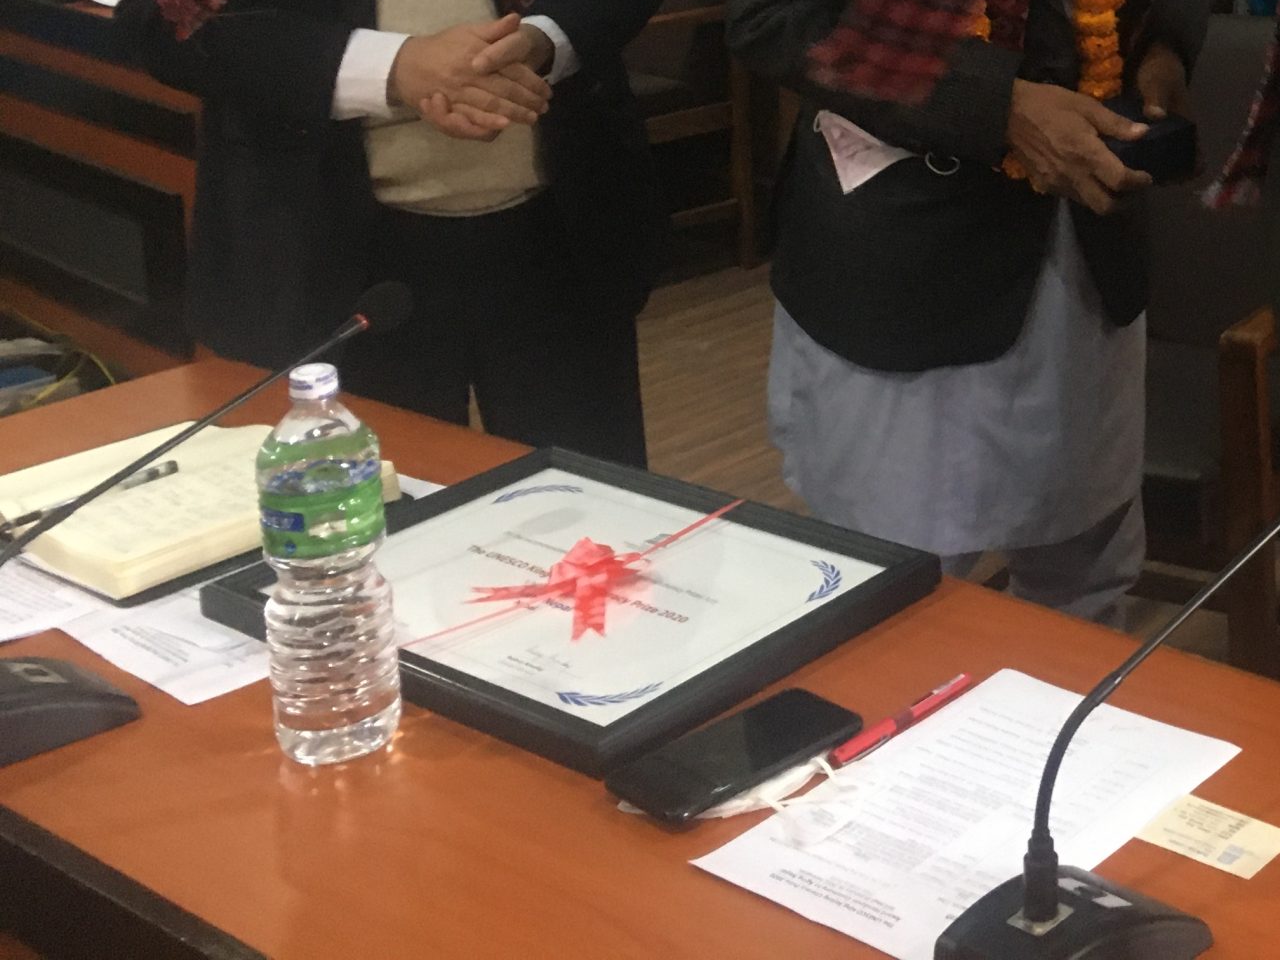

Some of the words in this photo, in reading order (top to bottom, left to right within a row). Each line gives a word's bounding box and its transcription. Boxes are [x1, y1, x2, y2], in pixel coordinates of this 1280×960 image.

[467, 544, 486, 555] The
[486, 550, 530, 570] UNESCO
[630, 599, 658, 615] Prize
[657, 608, 690, 624] 2020
